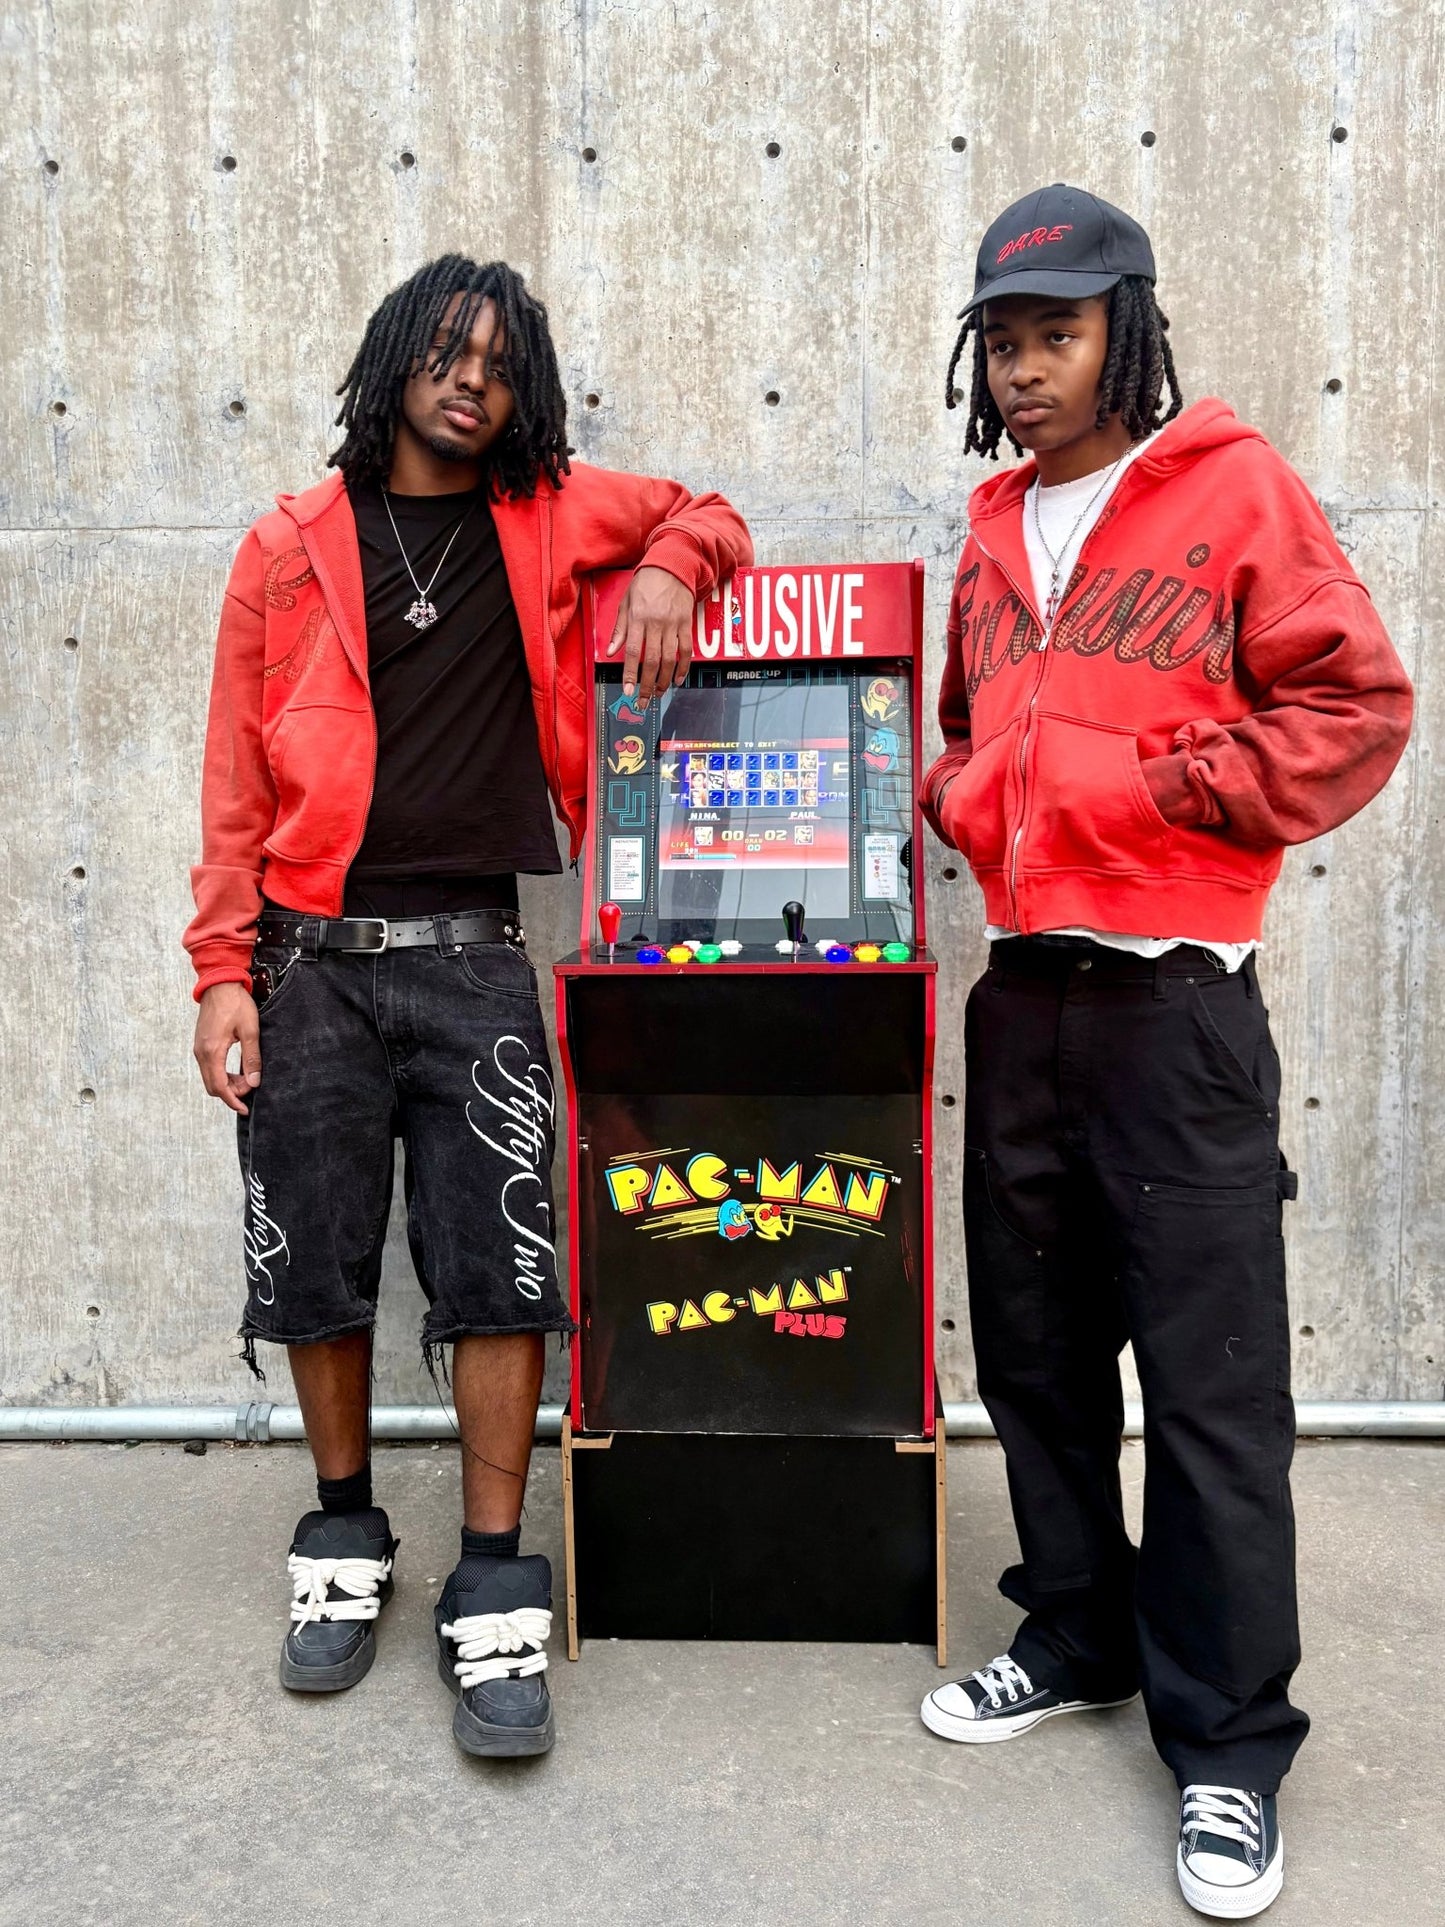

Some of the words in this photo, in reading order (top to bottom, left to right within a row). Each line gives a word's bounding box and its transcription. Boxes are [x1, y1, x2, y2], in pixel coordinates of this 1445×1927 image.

[691, 573, 864, 659] CLUSIVE
[605, 1152, 890, 1222] PAC-MAN
[646, 1267, 849, 1336] PAC-MAN
[774, 1310, 847, 1339] PLUS
